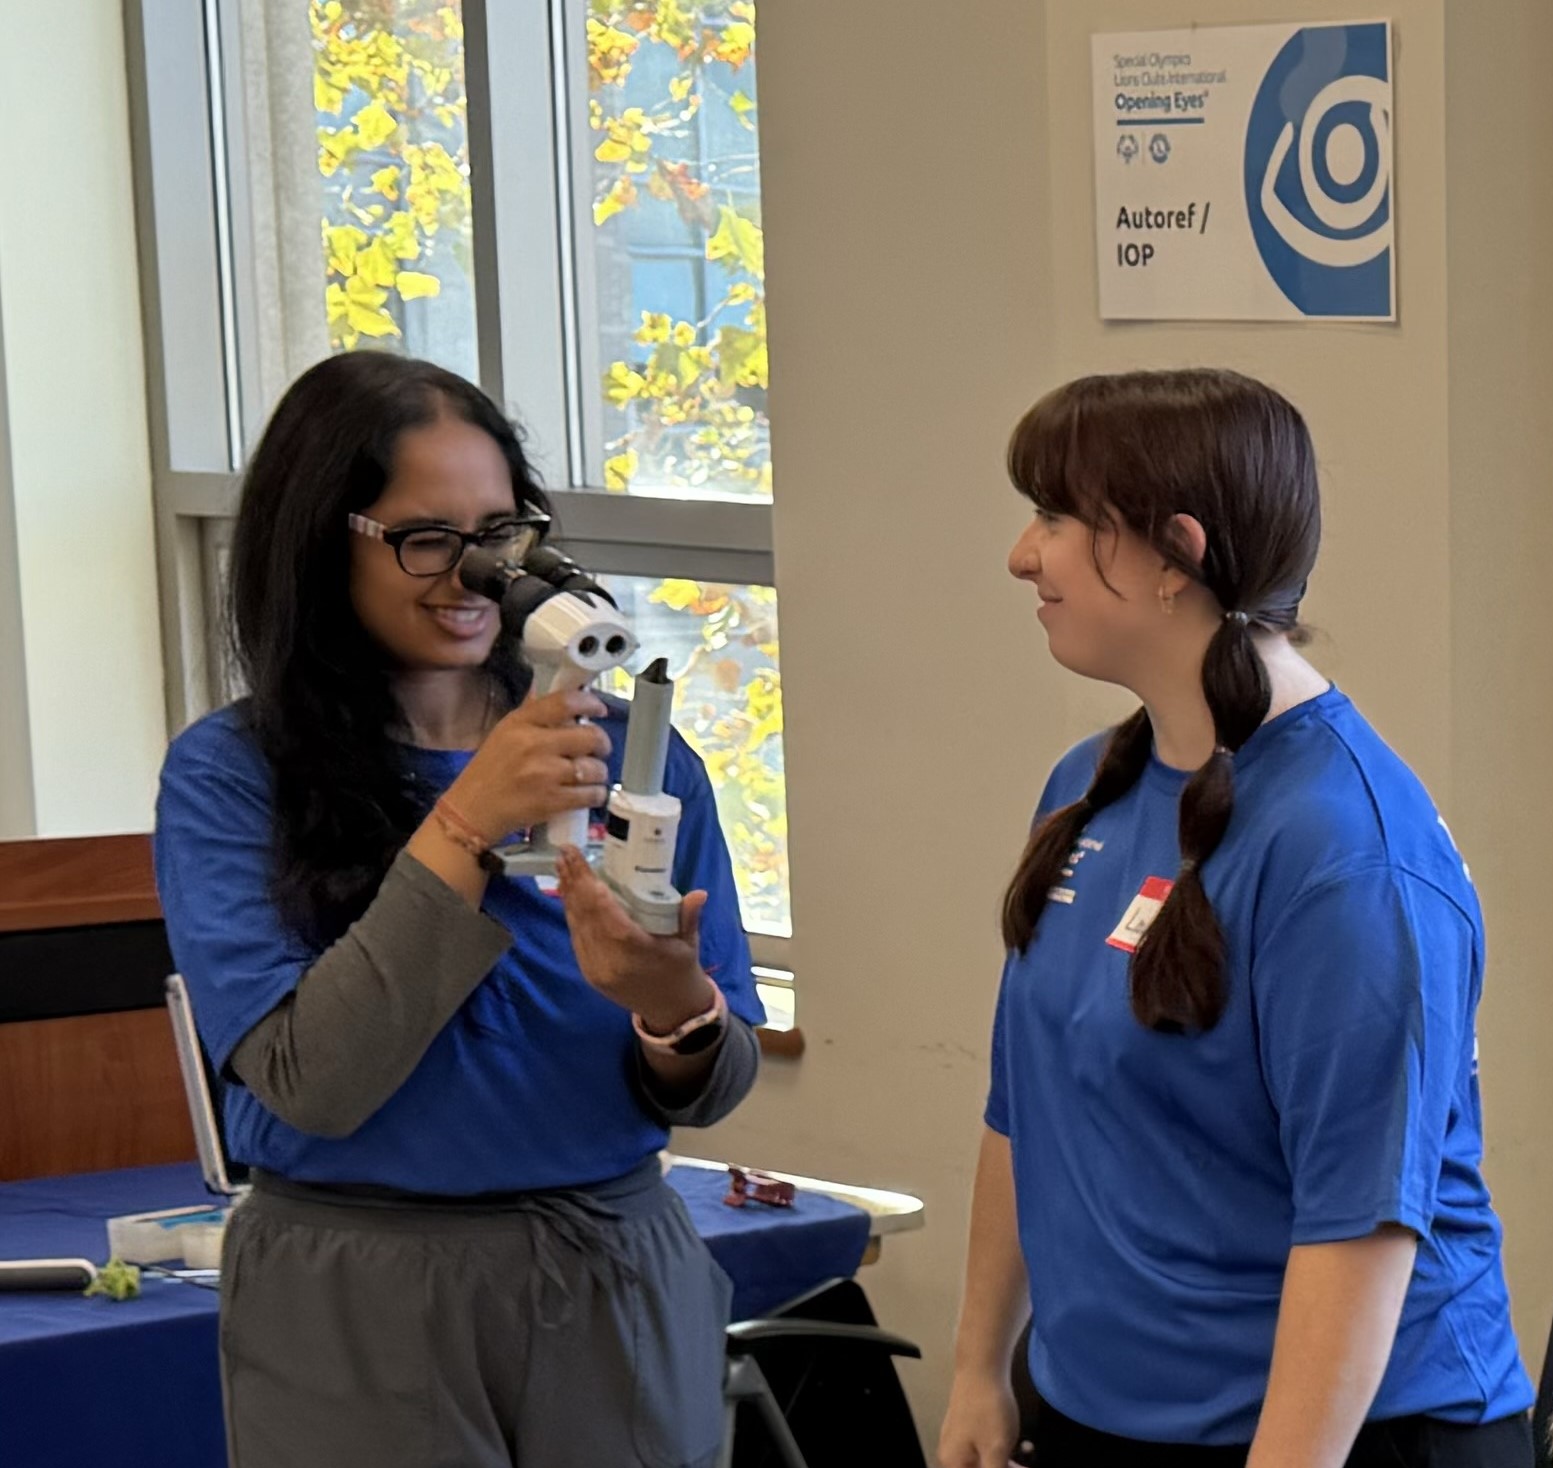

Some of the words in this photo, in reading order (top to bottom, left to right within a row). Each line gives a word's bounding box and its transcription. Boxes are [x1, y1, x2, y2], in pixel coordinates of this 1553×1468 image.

[1115, 92, 1171, 113] Opening
[1116, 202, 1196, 229] Autoref
[1199, 201, 1210, 234] /
[1117, 243, 1154, 267] IOP
